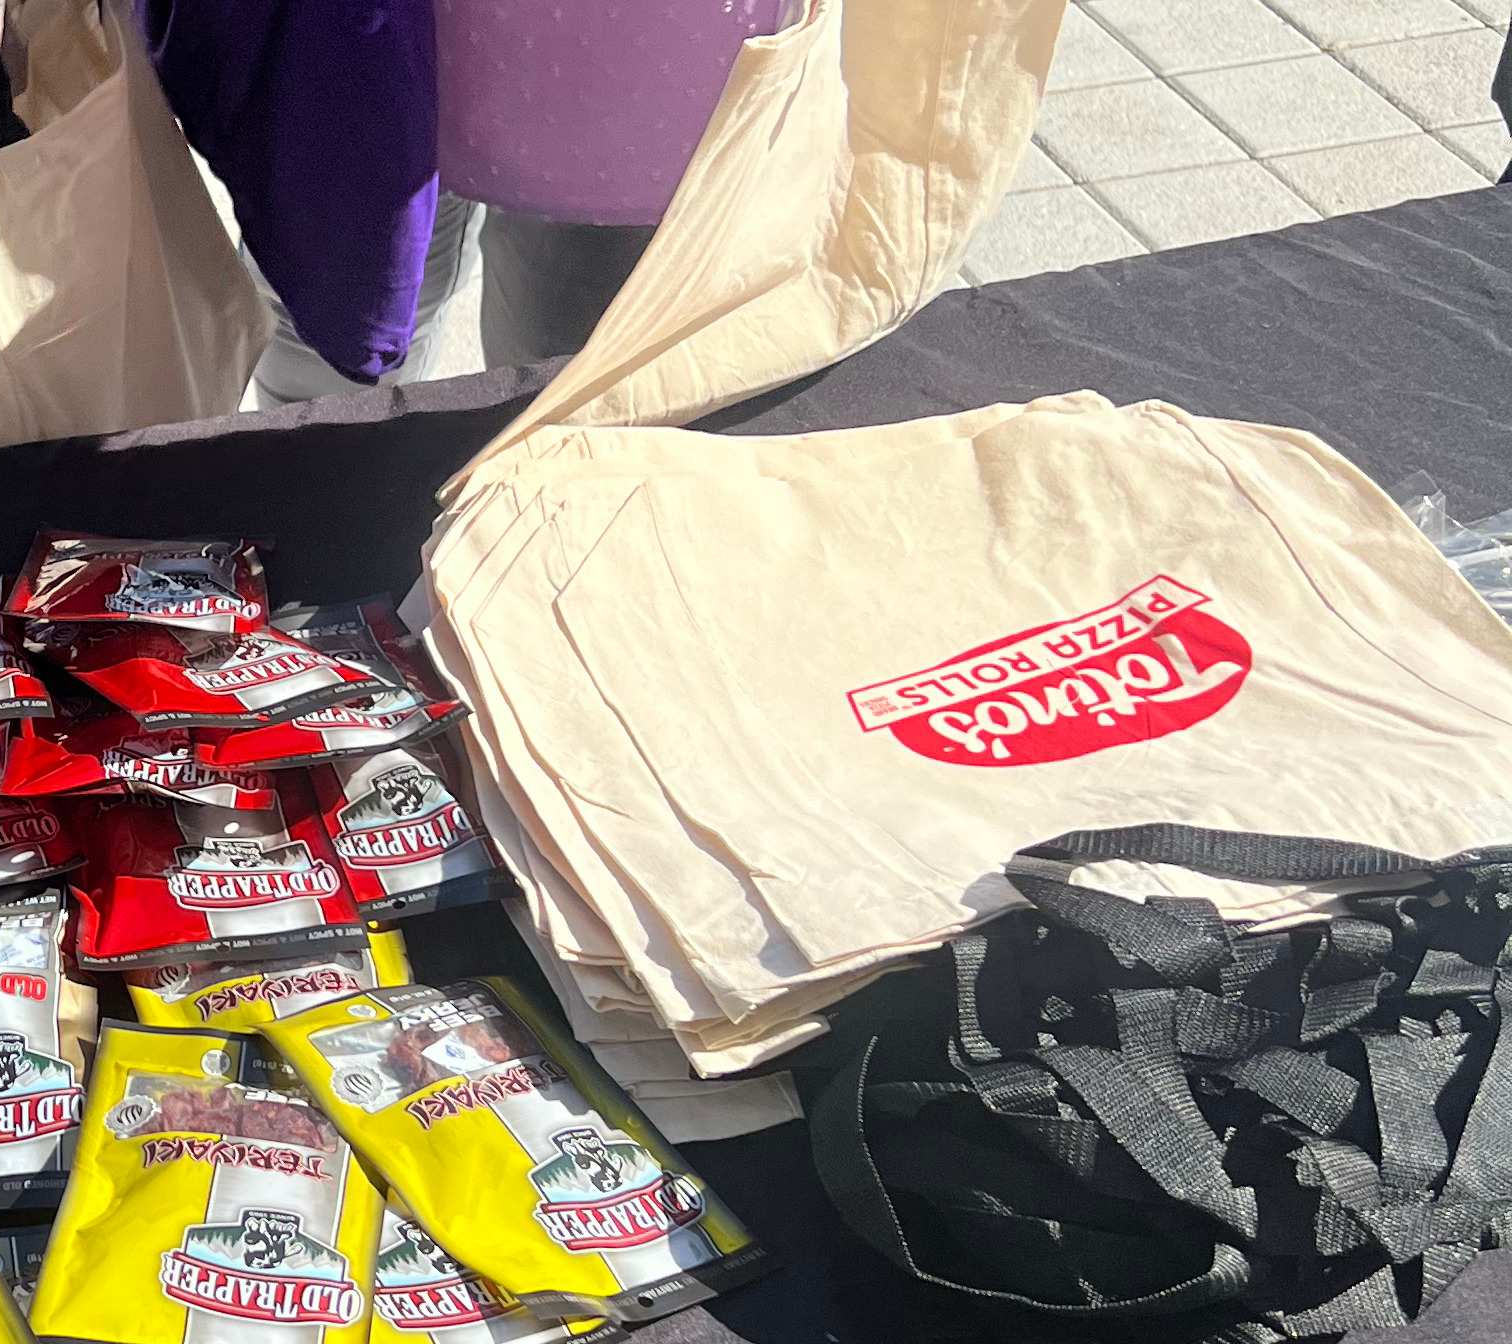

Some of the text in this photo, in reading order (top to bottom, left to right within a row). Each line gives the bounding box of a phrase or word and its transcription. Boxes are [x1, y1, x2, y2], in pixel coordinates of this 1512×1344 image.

[1044, 591, 1179, 659] PIZZA
[895, 649, 1041, 708] ROLLS
[928, 633, 1245, 759] Totino's
[12, 815, 58, 842] OLD
[334, 810, 458, 859] TRAPPER
[168, 866, 337, 901] OLD TRAPPER
[194, 969, 362, 1022] TERIYAKI
[141, 1137, 334, 1184] TERIYAKI
[160, 1253, 361, 1322] OLD TRAPPER
